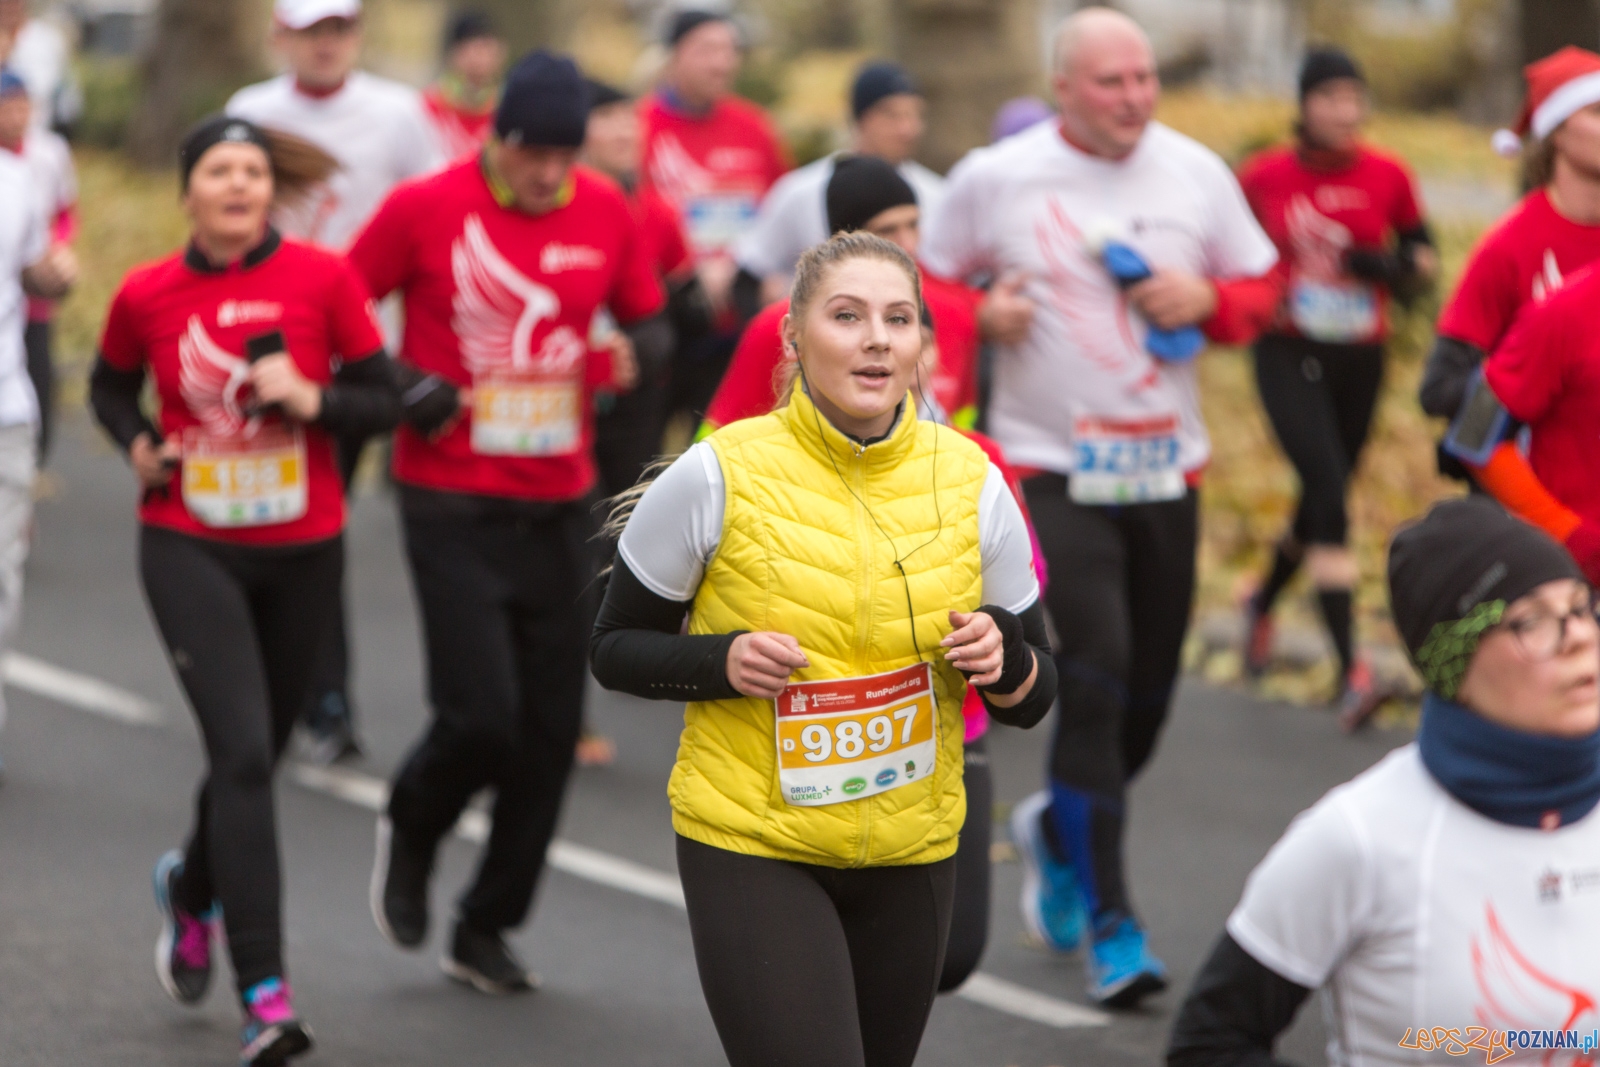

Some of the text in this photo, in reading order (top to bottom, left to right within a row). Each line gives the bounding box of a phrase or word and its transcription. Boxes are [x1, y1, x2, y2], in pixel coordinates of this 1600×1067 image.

[866, 677, 921, 699] RunPoland.org
[783, 704, 918, 763] D 9897
[790, 786, 817, 794] GRUPA
[791, 793, 823, 801] LUXMED
